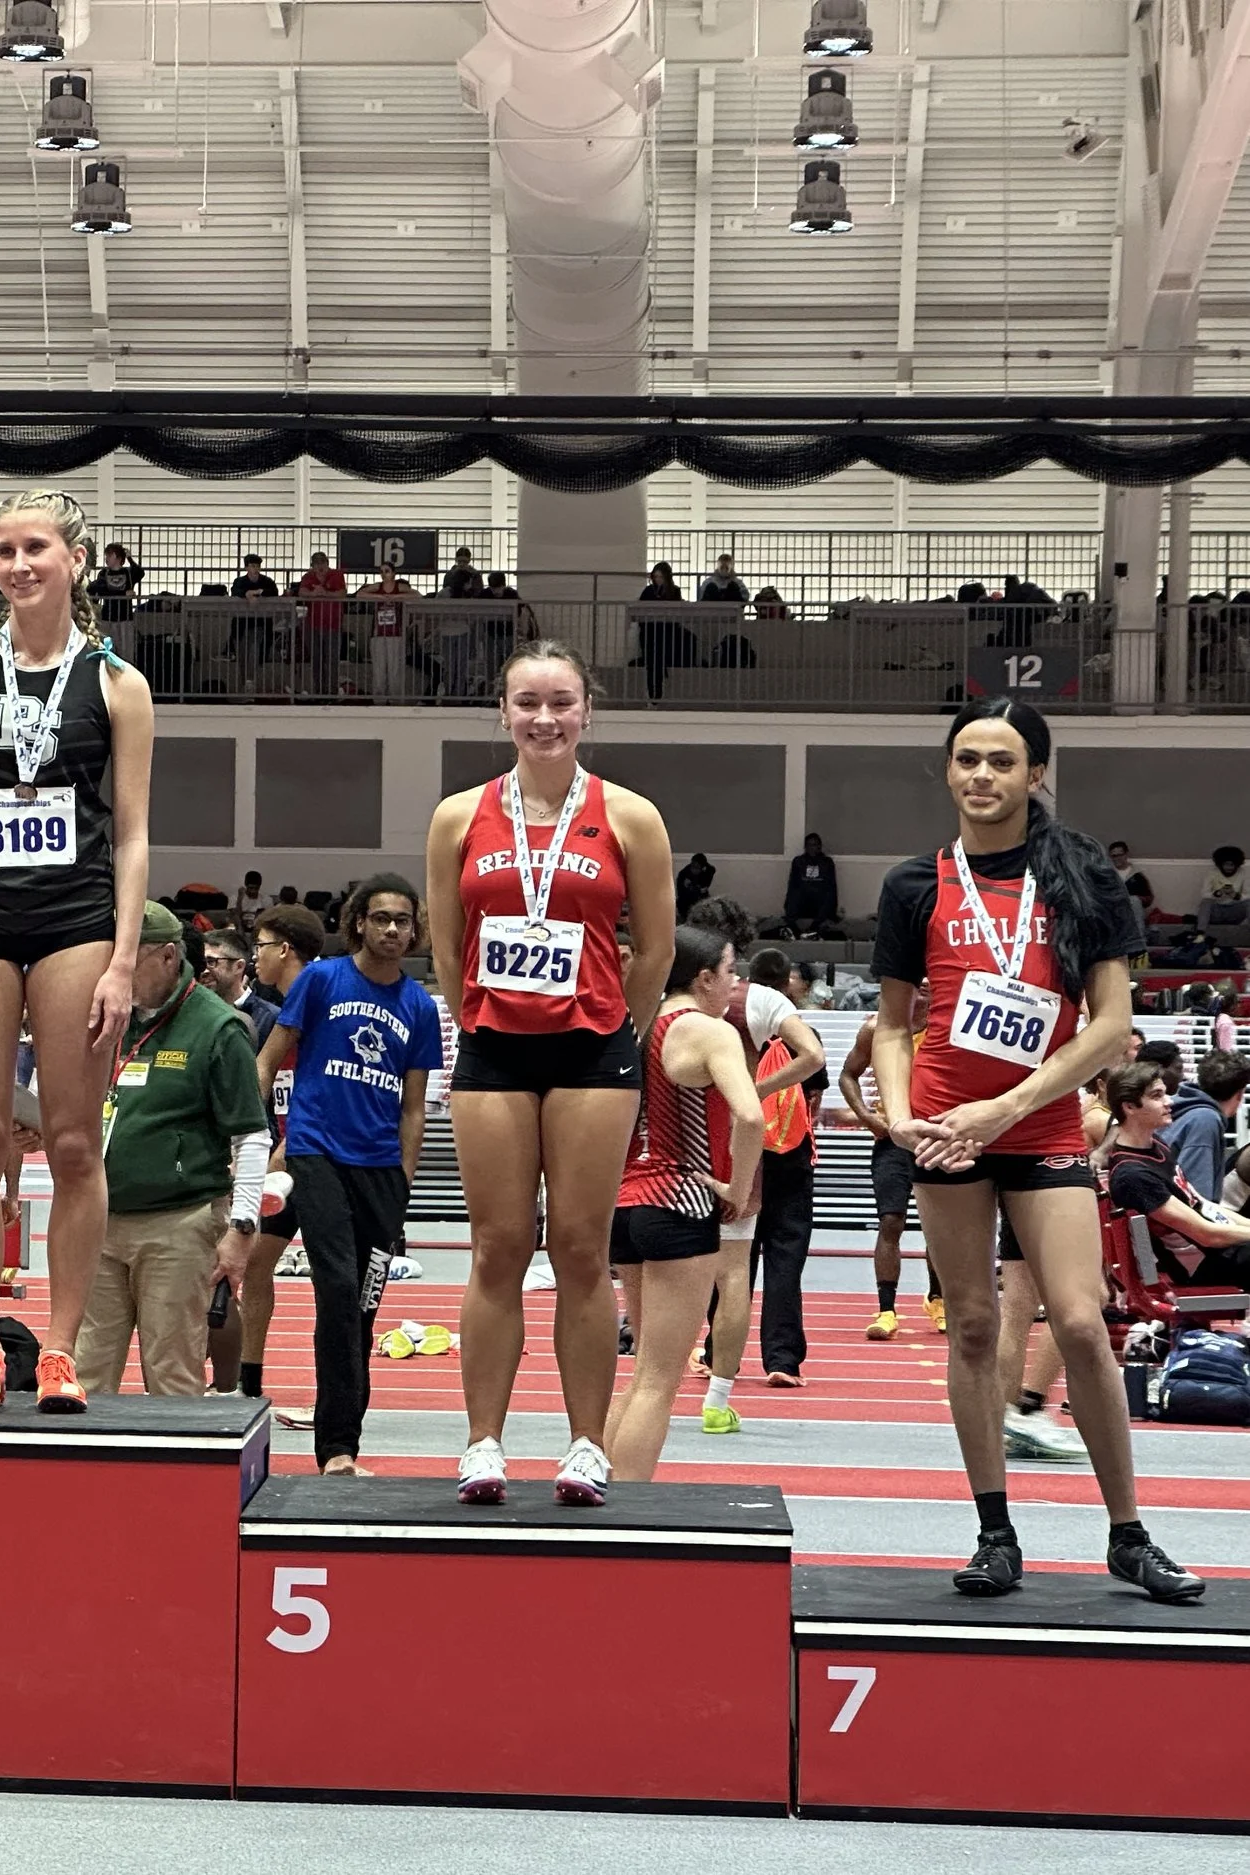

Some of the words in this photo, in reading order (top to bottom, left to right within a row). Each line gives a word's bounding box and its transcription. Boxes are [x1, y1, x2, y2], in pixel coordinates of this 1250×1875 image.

[370, 537, 405, 568] 16
[1004, 654, 1043, 687] 12
[486, 940, 573, 983] 8225
[1006, 982, 1025, 993] MIAA
[328, 1001, 410, 1045] SOUTHEASTERN
[960, 998, 1046, 1053] 7658
[324, 1059, 399, 1093] ATHLETICS
[266, 1566, 330, 1653] 5
[827, 1666, 877, 1733] 7
